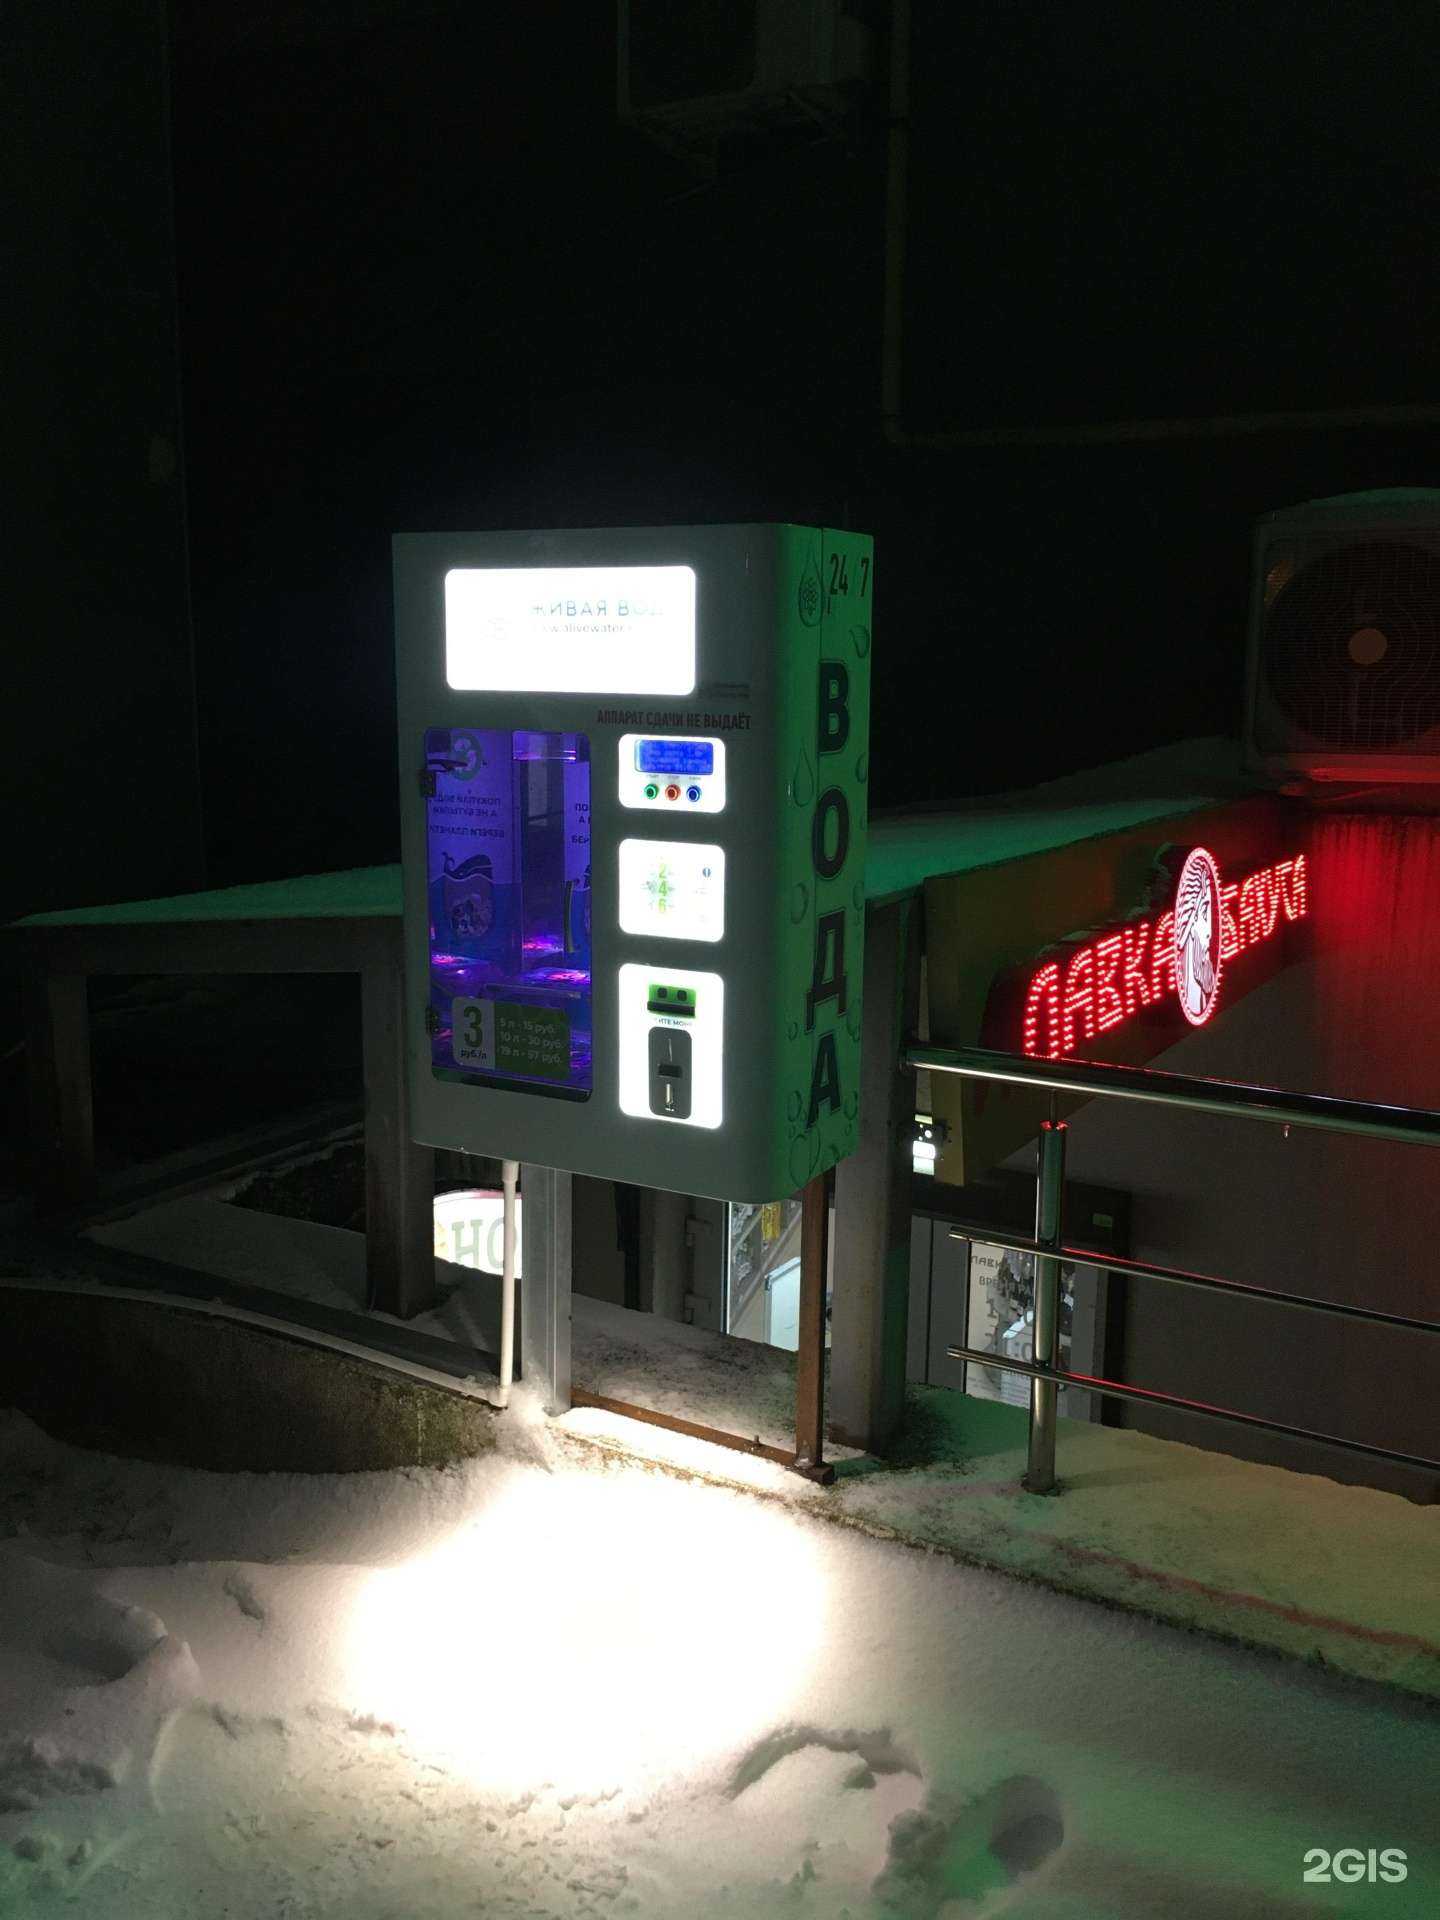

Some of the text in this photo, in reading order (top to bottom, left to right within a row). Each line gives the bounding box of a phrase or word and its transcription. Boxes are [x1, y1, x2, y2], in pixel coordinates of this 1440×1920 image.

[829, 553, 848, 596] 24
[597, 709, 752, 731] АППАРАТ СДАЧИ НЕ ВЫДАЁТ
[804, 660, 850, 1129] ВОДА
[1023, 909, 1178, 1058] ЛАВКА
[463, 1006, 482, 1048] 3
